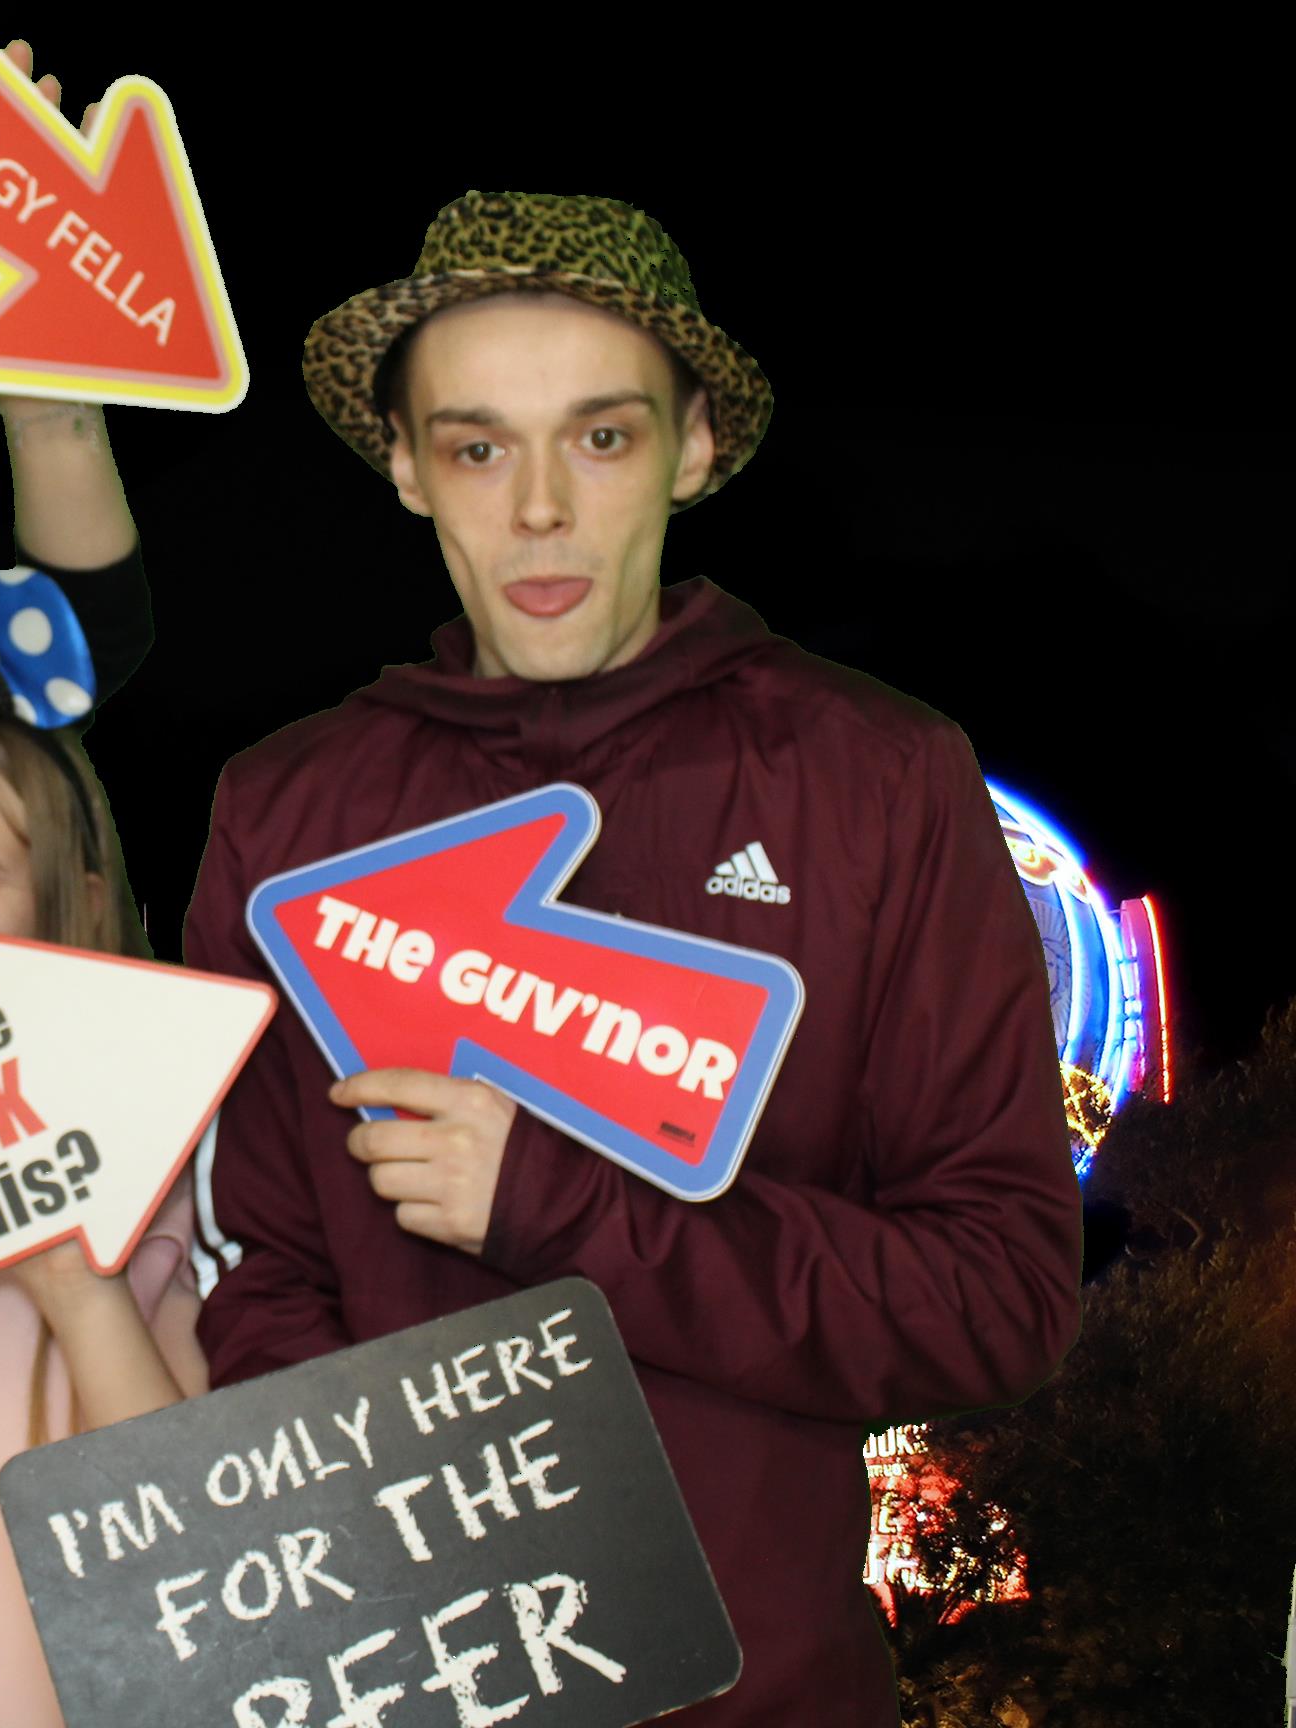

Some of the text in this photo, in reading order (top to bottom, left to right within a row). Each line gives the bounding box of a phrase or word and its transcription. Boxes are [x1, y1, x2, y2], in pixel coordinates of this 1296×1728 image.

[47, 210, 175, 346] FELLA
[705, 875, 792, 905] adidas
[48, 1308, 592, 1578] I'M ONLY HERE
[155, 1420, 580, 1662] FOR THE
